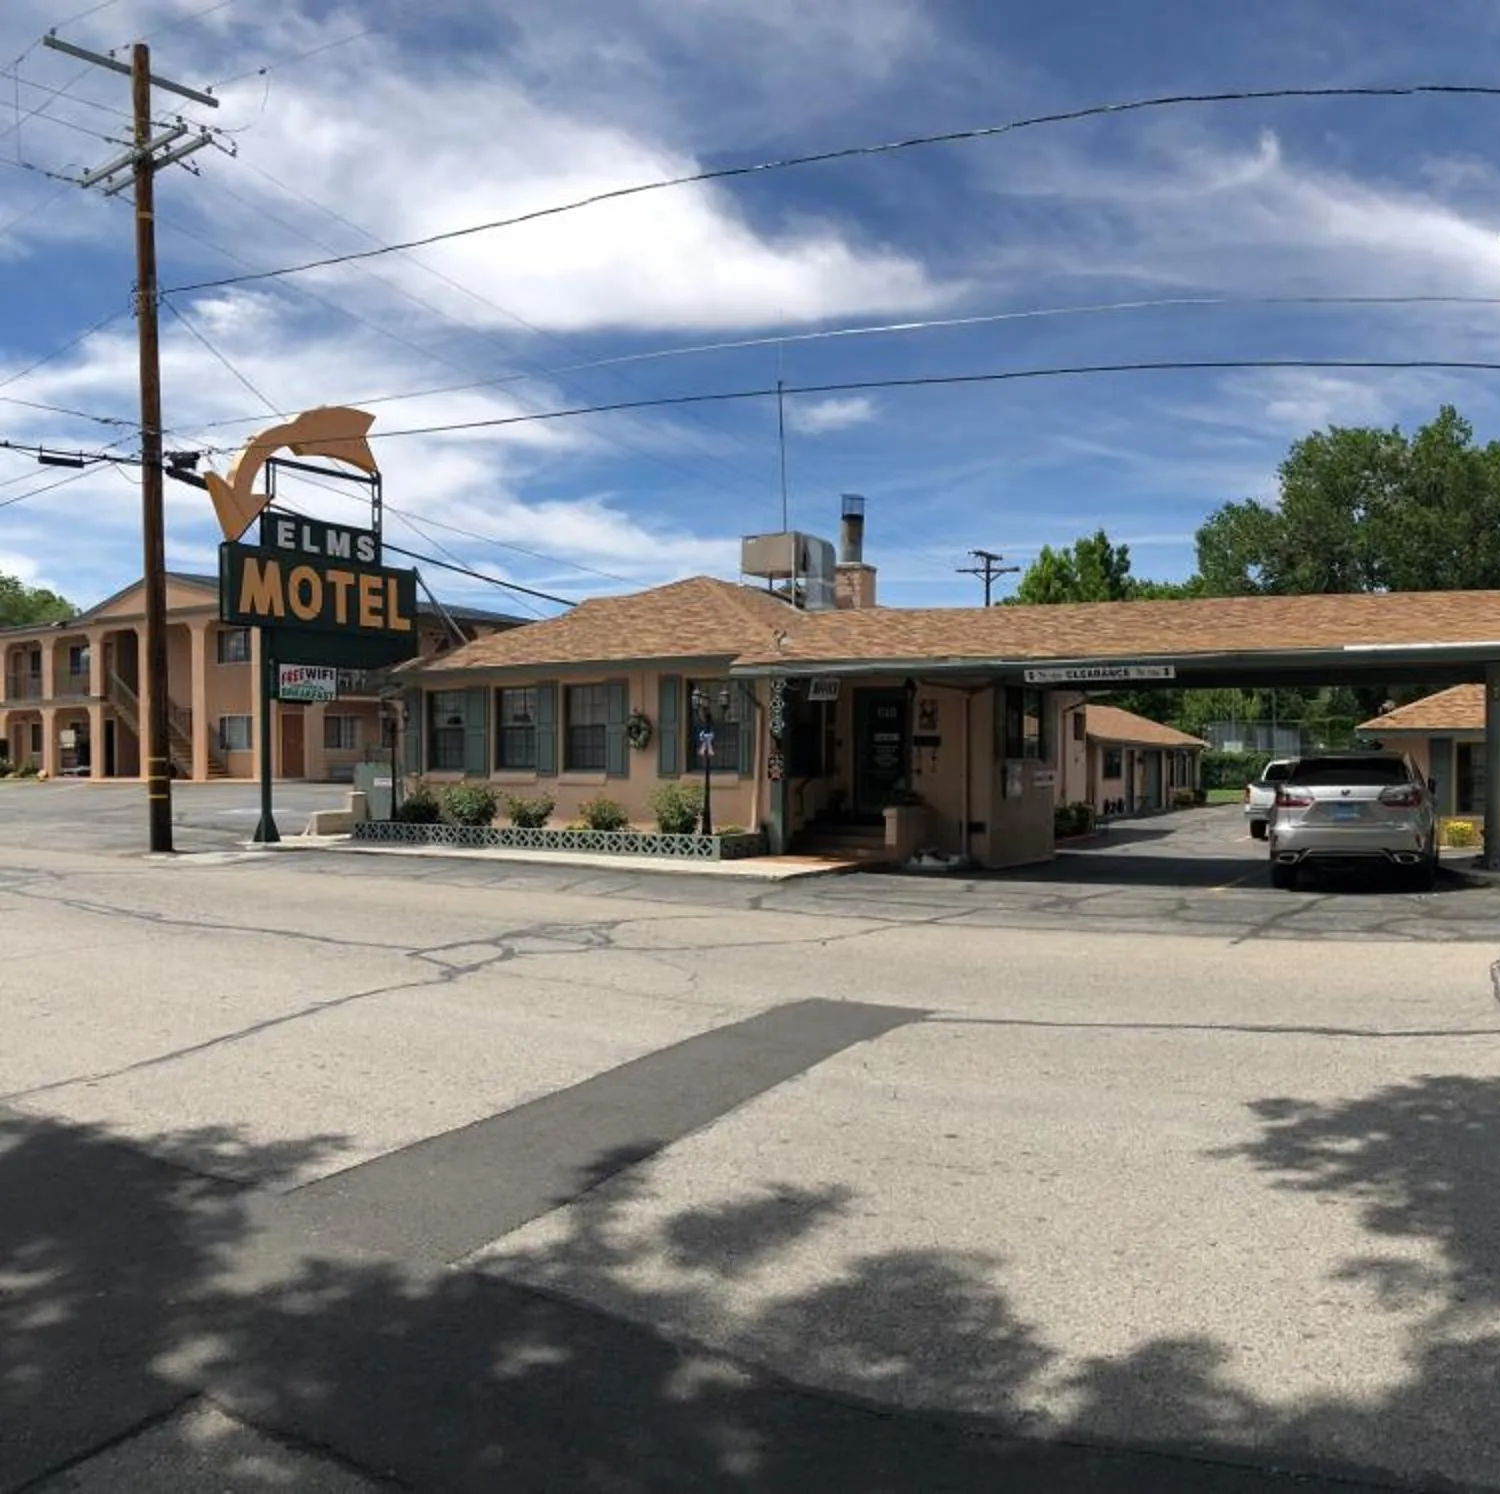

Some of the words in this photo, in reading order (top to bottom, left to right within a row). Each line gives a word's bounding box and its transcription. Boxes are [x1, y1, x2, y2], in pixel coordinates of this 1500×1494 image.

[277, 520, 376, 563] ELMS
[239, 557, 412, 631] MOTEL
[305, 667, 334, 681] WIFI
[1066, 667, 1130, 679] CLEARANCE
